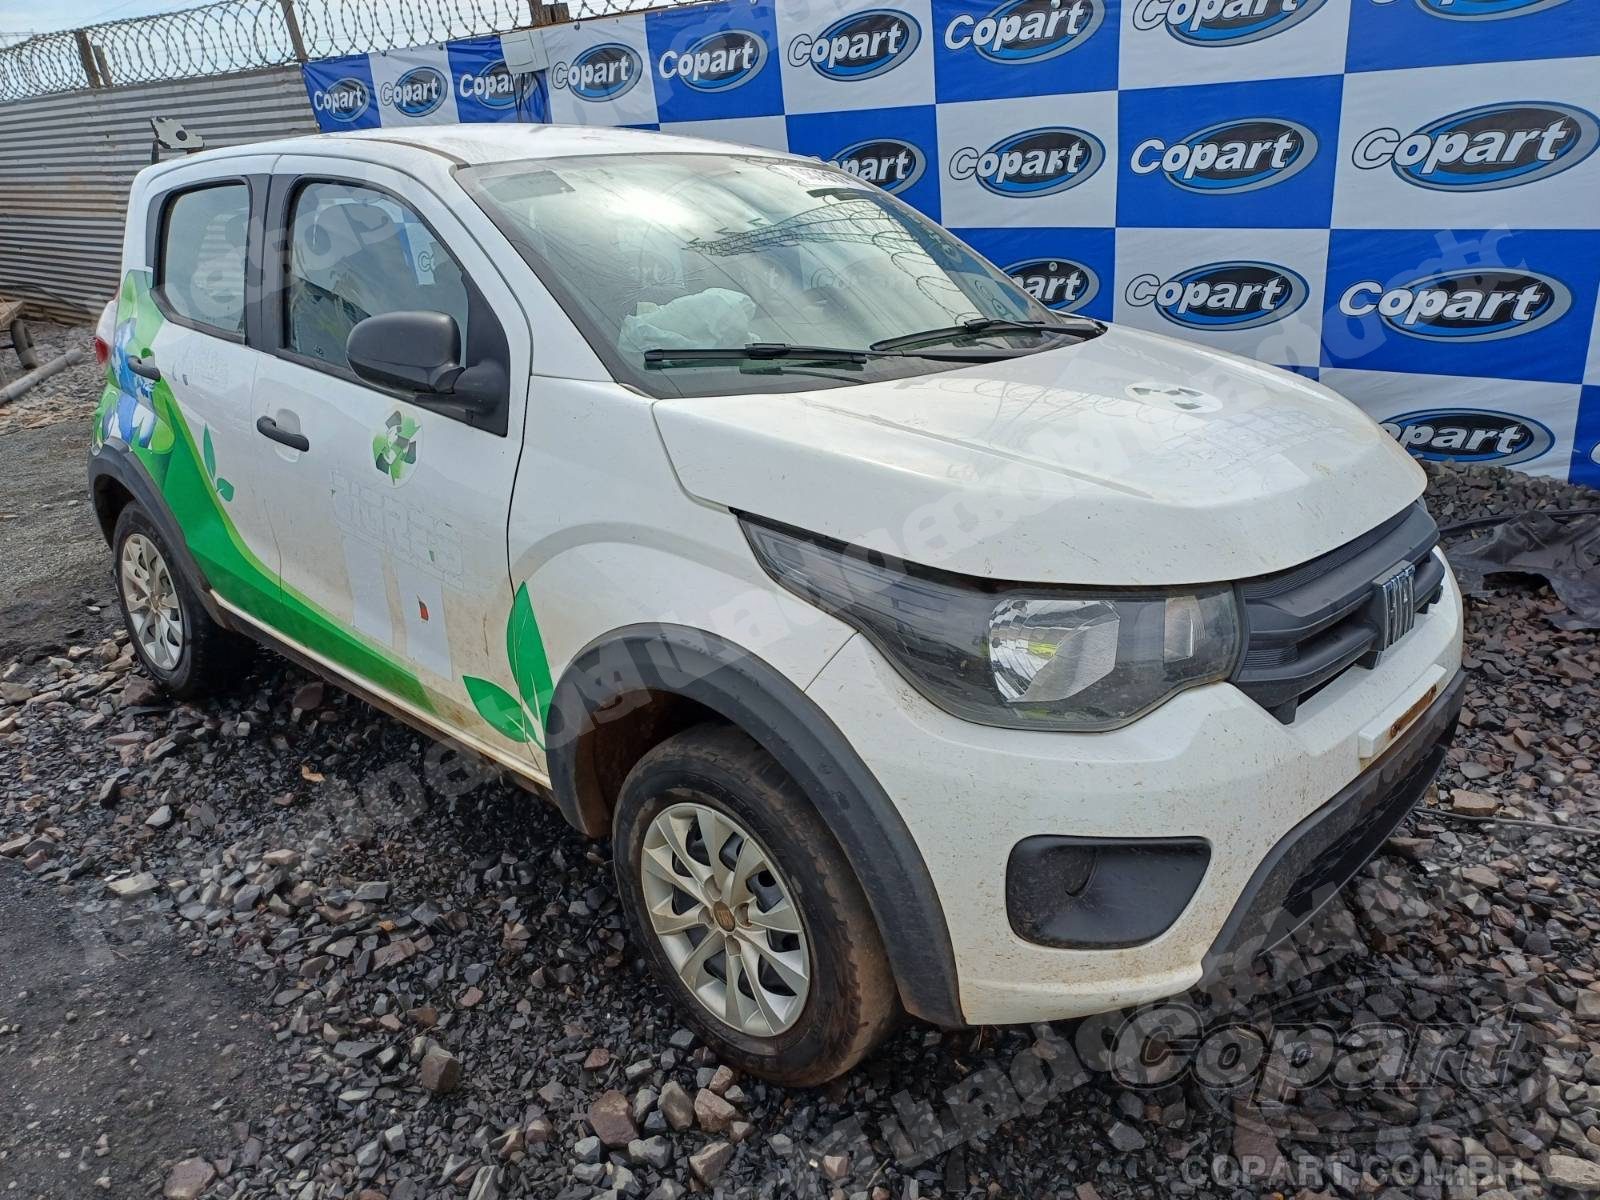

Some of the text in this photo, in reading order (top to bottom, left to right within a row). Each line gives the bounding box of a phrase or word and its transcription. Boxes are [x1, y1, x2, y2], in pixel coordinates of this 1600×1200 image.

[788, 22, 903, 69] Copart
[944, 0, 1084, 52] Copart
[552, 56, 631, 90] Copart
[659, 39, 754, 82] Copart
[314, 87, 363, 113] Copart
[380, 75, 439, 107] Copart
[459, 73, 528, 100] Copar
[823, 151, 909, 180] part
[949, 140, 1085, 184] Copart
[1130, 128, 1297, 179] Copart
[1352, 117, 1571, 175] Copart
[1011, 271, 1081, 301] art
[1125, 274, 1284, 315] Copart
[1339, 281, 1544, 325] Copart
[1380, 421, 1525, 454] opart
